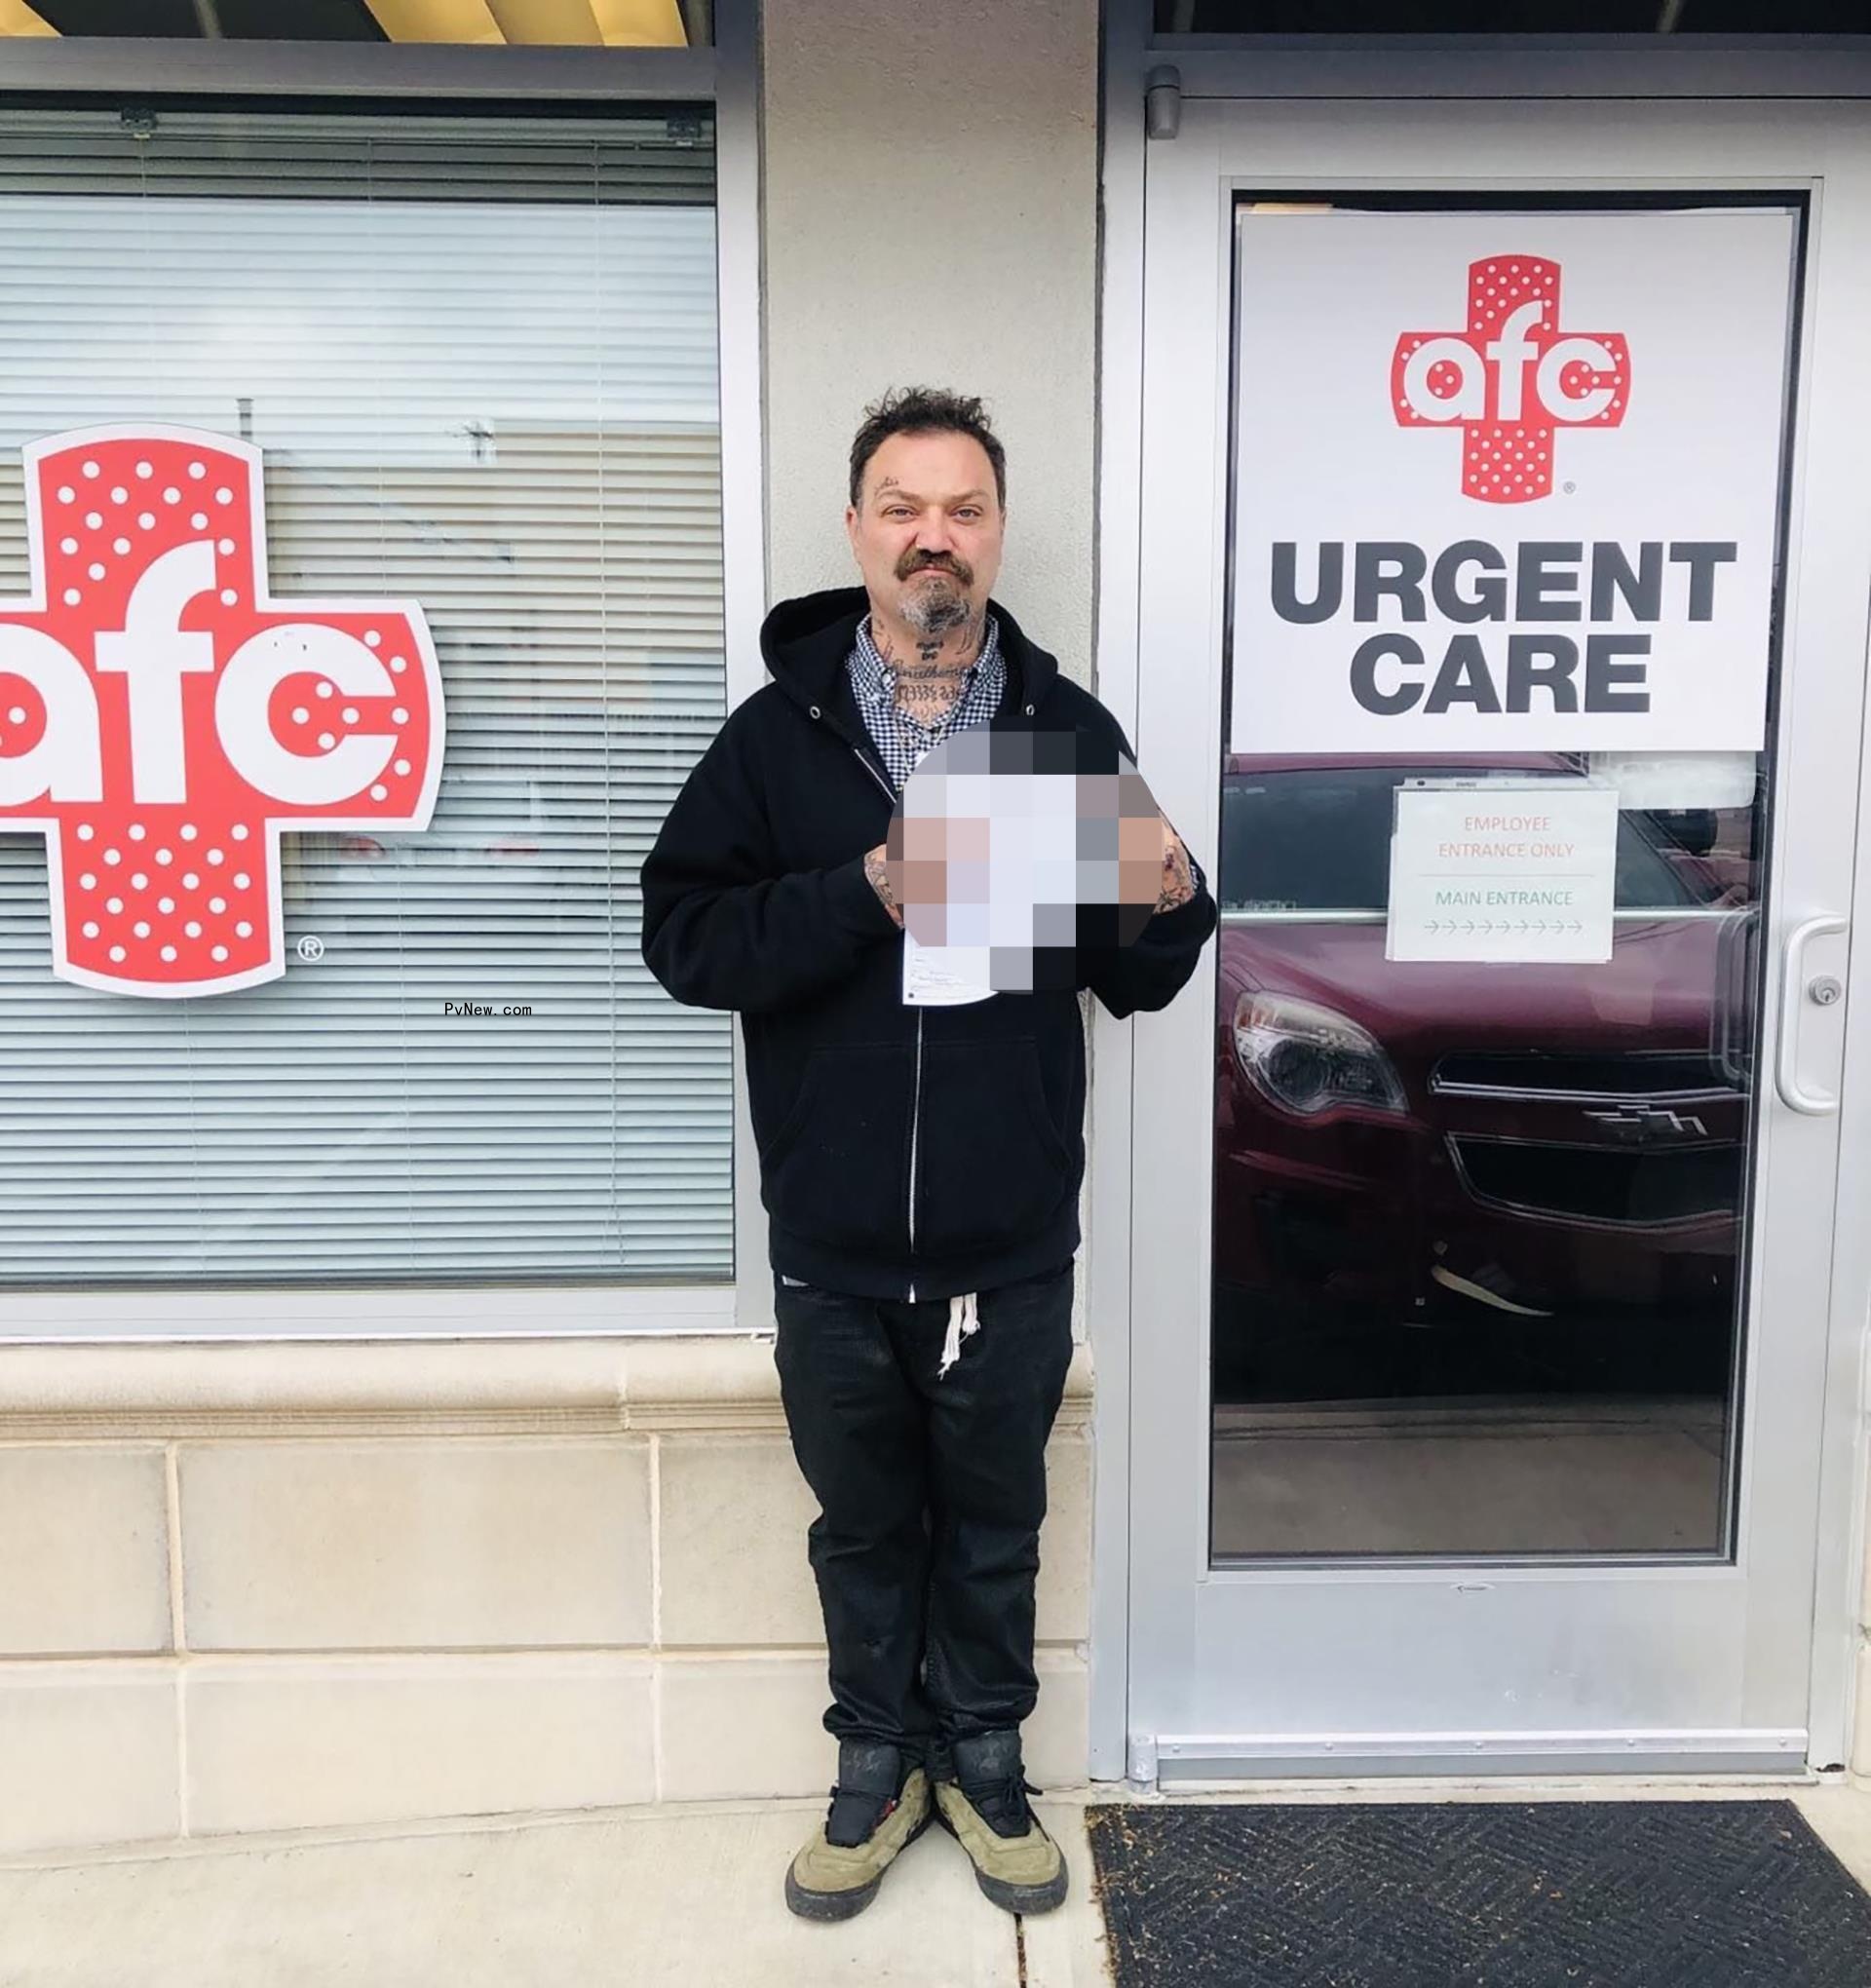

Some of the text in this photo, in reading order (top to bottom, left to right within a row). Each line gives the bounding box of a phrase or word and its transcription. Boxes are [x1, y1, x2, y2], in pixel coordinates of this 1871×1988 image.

[1403, 300, 1617, 422] afc
[1271, 539, 1737, 625] URGENT
[1350, 632, 1652, 716] CARE
[1465, 816, 1551, 831] EMPLOYEE
[1438, 843, 1575, 858] ENTRANCE ONLY
[1434, 891, 1574, 905] MAIN ENTRANCE
